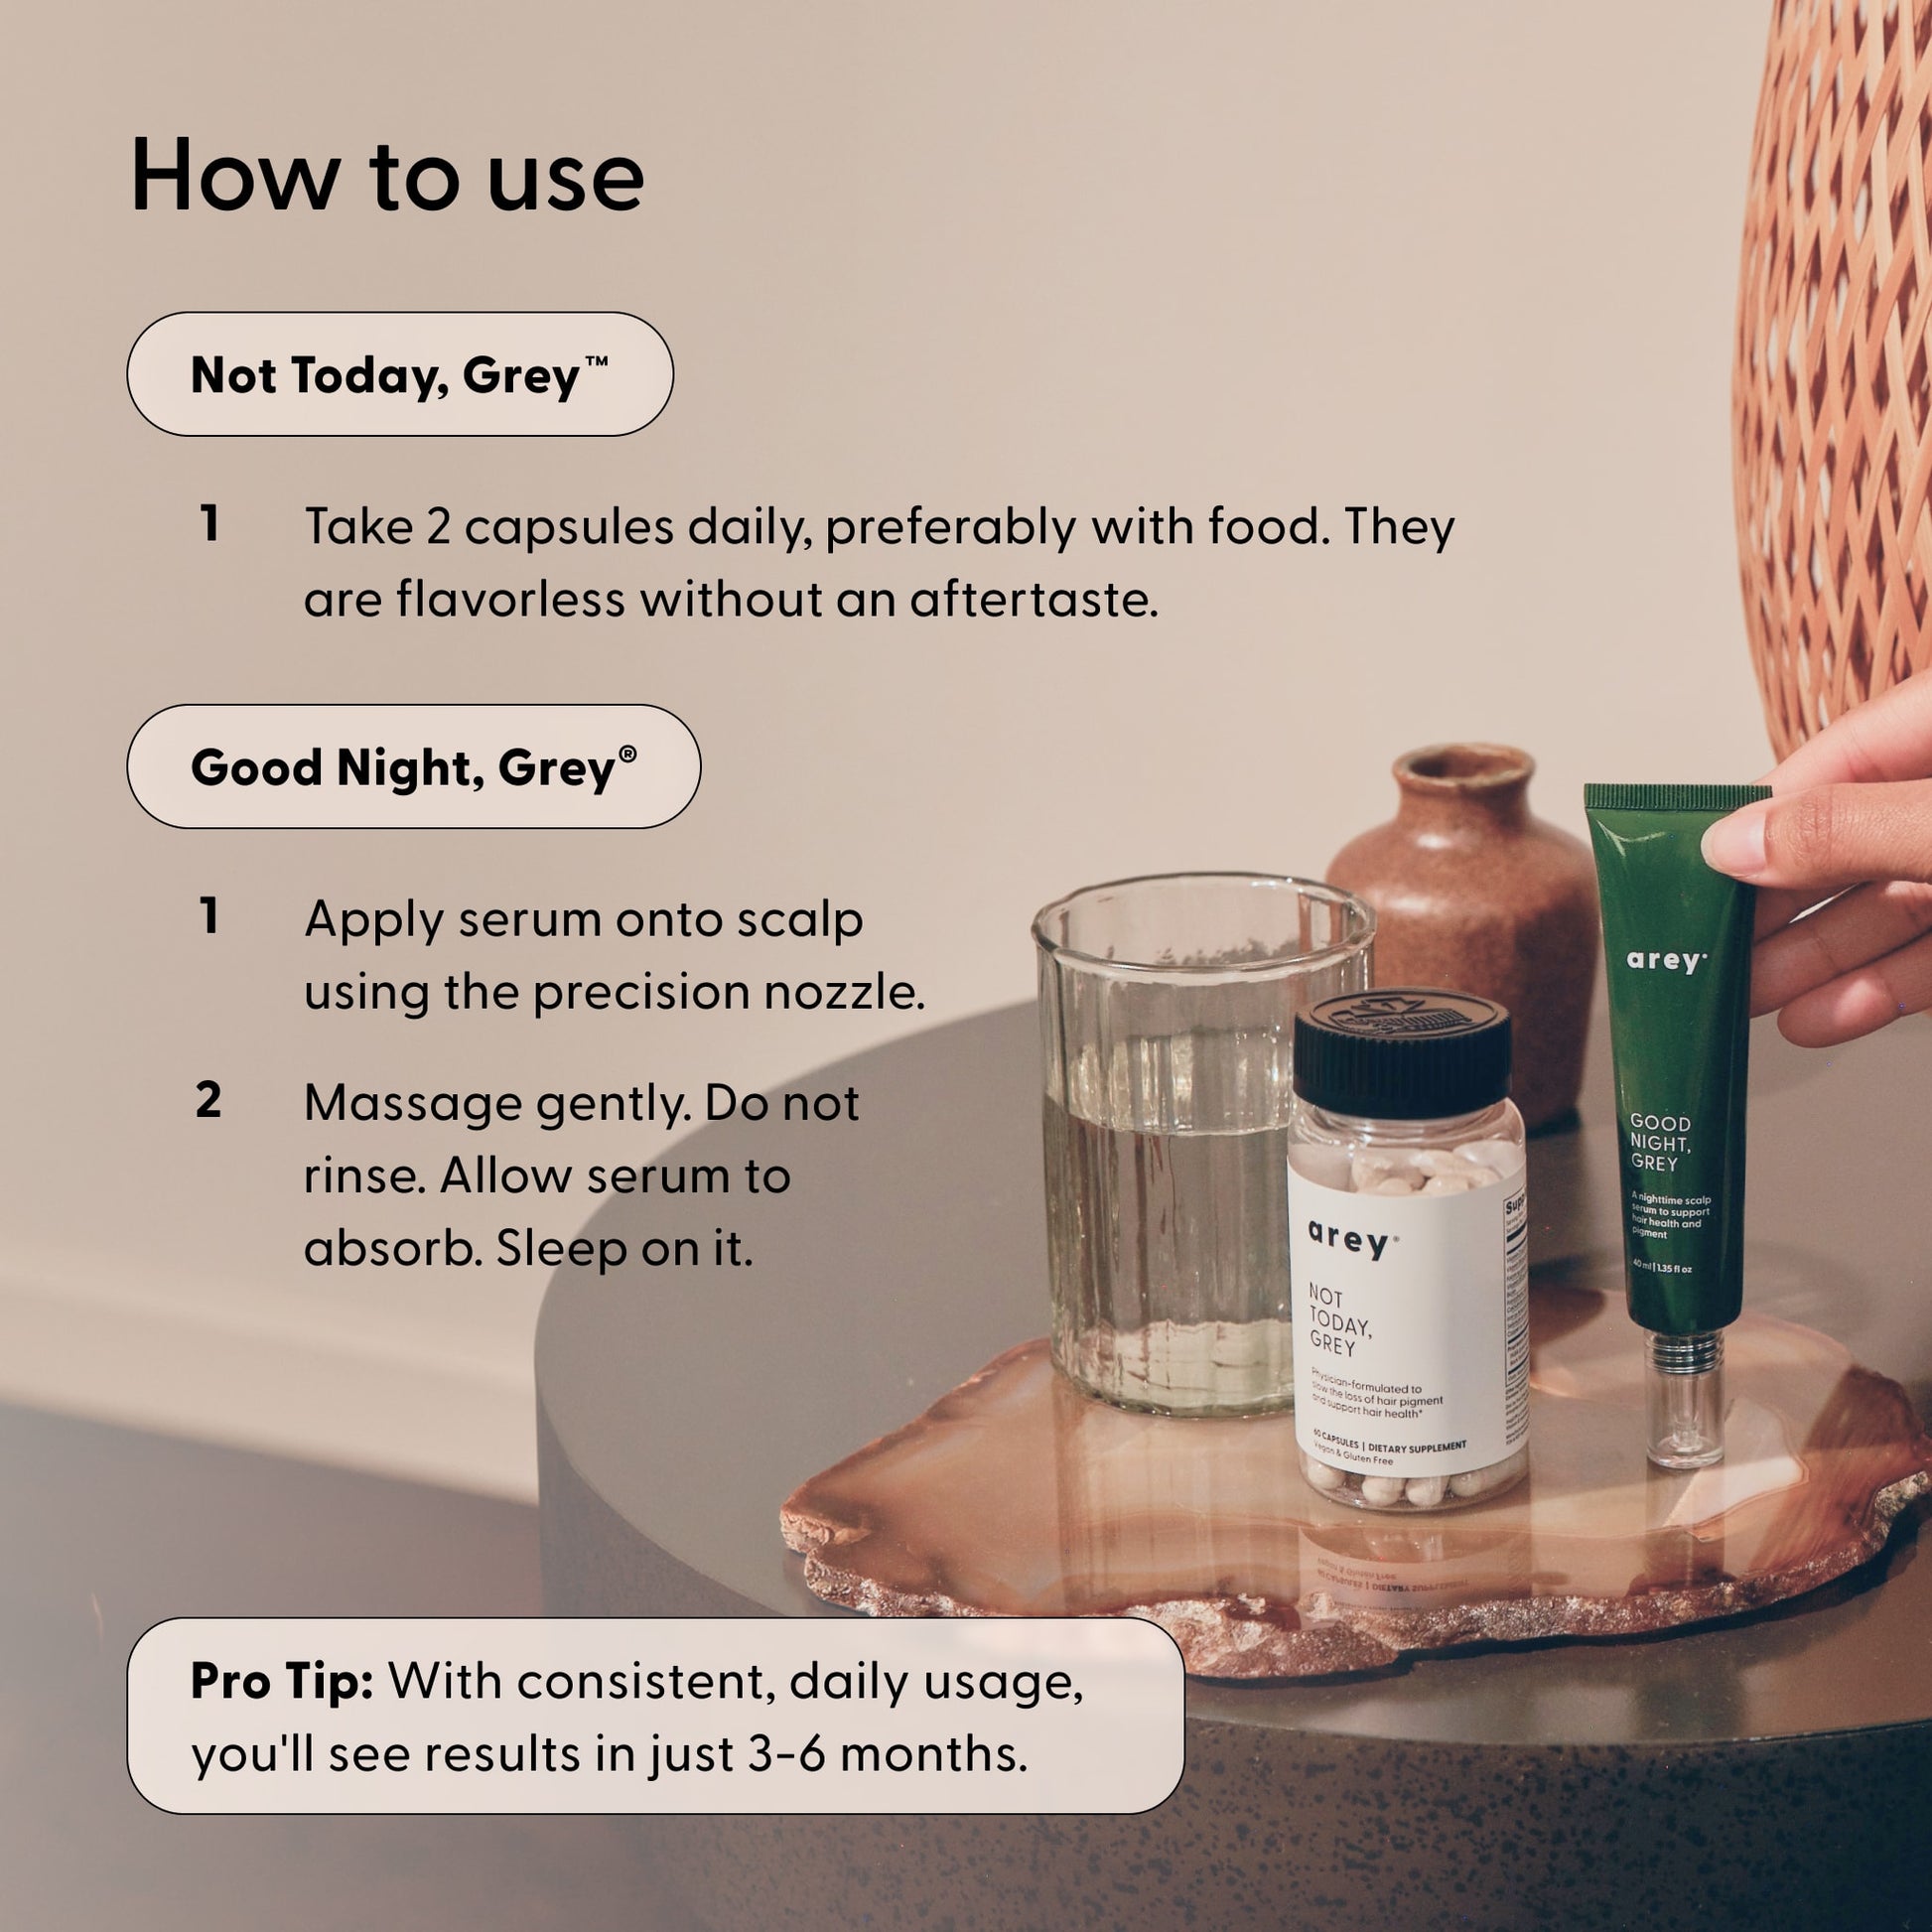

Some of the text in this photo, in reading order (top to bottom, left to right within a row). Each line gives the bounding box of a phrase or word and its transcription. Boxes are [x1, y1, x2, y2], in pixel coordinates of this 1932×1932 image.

[1630, 1112, 1692, 1132] GOOD
[1631, 1132, 1692, 1155] NIGHT,
[1631, 1153, 1678, 1172] GREY
[1631, 1190, 1712, 1205] A nighttime scalp
[1631, 1202, 1711, 1218] serum to support
[1631, 1213, 1702, 1228] hair health and
[1632, 1225, 1668, 1239] pigment
[1633, 1258, 1642, 1268] 40
[1310, 1281, 1343, 1309] NOT
[1310, 1305, 1373, 1340] TODAY,
[1311, 1329, 1355, 1357] GREY
[1329, 1386, 1343, 1399] the
[1344, 1390, 1363, 1403] loss
[1364, 1394, 1375, 1404] of
[1376, 1395, 1397, 1406] hair
[1399, 1395, 1444, 1409] pigment
[1411, 1385, 1423, 1394] to
[1327, 1398, 1361, 1415] support
[1362, 1406, 1382, 1417] hair
[1321, 1431, 1359, 1449] CAPSULES
[1368, 1443, 1408, 1454] DIETARY
[1409, 1440, 1467, 1454] SUPPLEMENT
[1343, 1450, 1372, 1464] Gluten
[1373, 1455, 1394, 1466] Free
